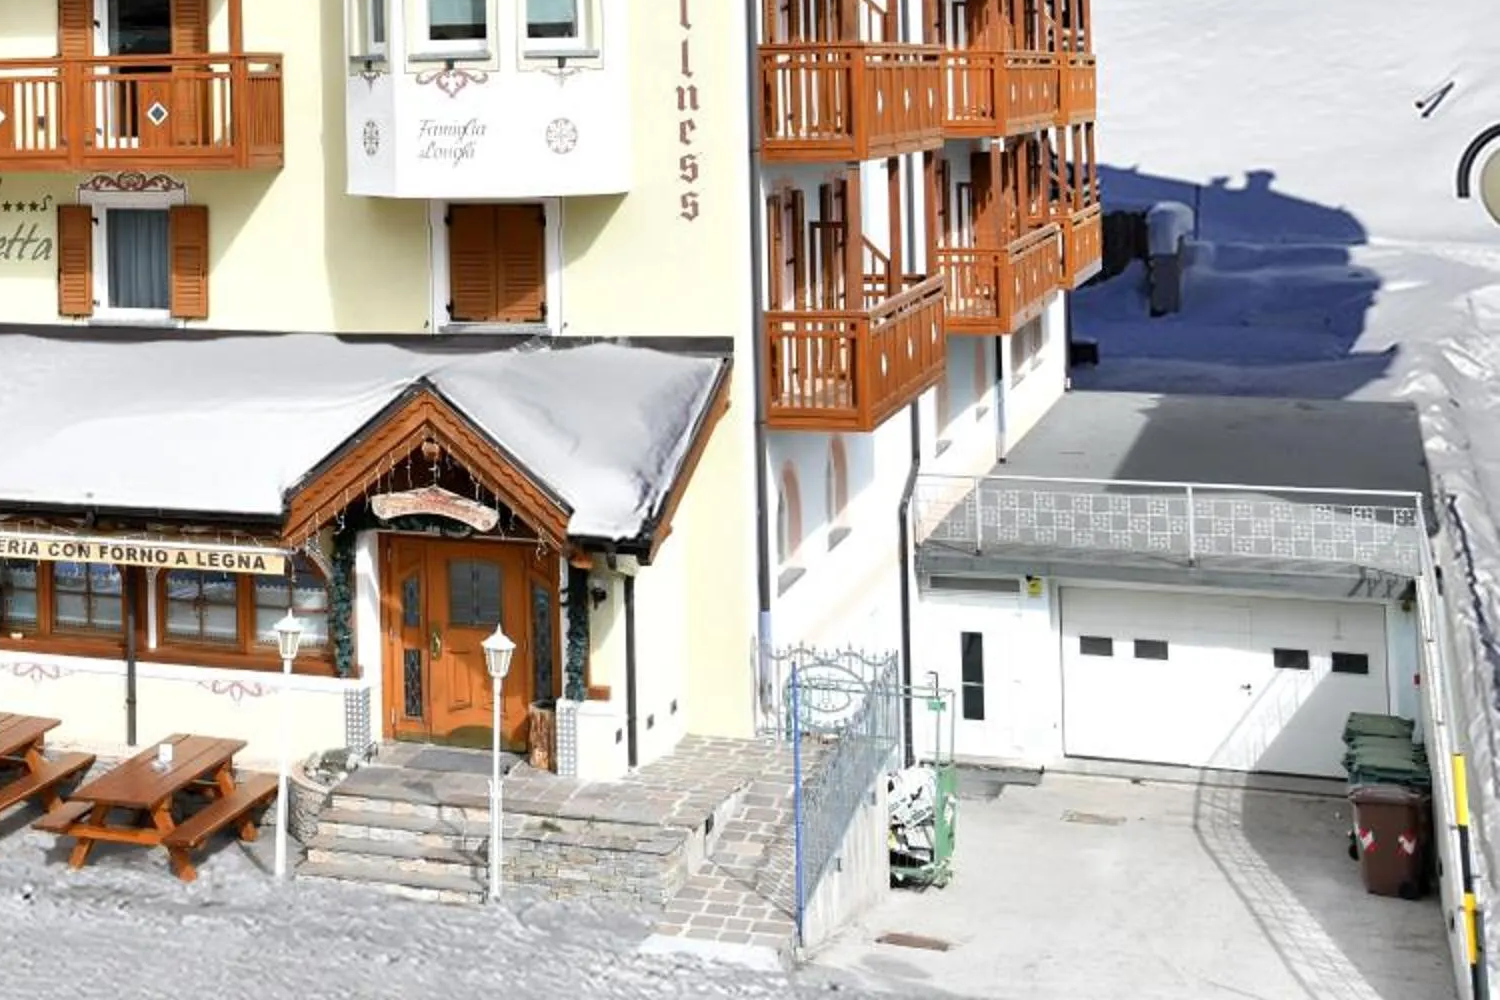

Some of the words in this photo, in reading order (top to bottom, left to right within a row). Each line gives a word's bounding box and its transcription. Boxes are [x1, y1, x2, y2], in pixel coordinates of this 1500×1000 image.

[48, 542, 91, 559] CON
[99, 545, 168, 564] FORNO
[175, 551, 189, 566] A
[197, 551, 267, 571] LEGNA
